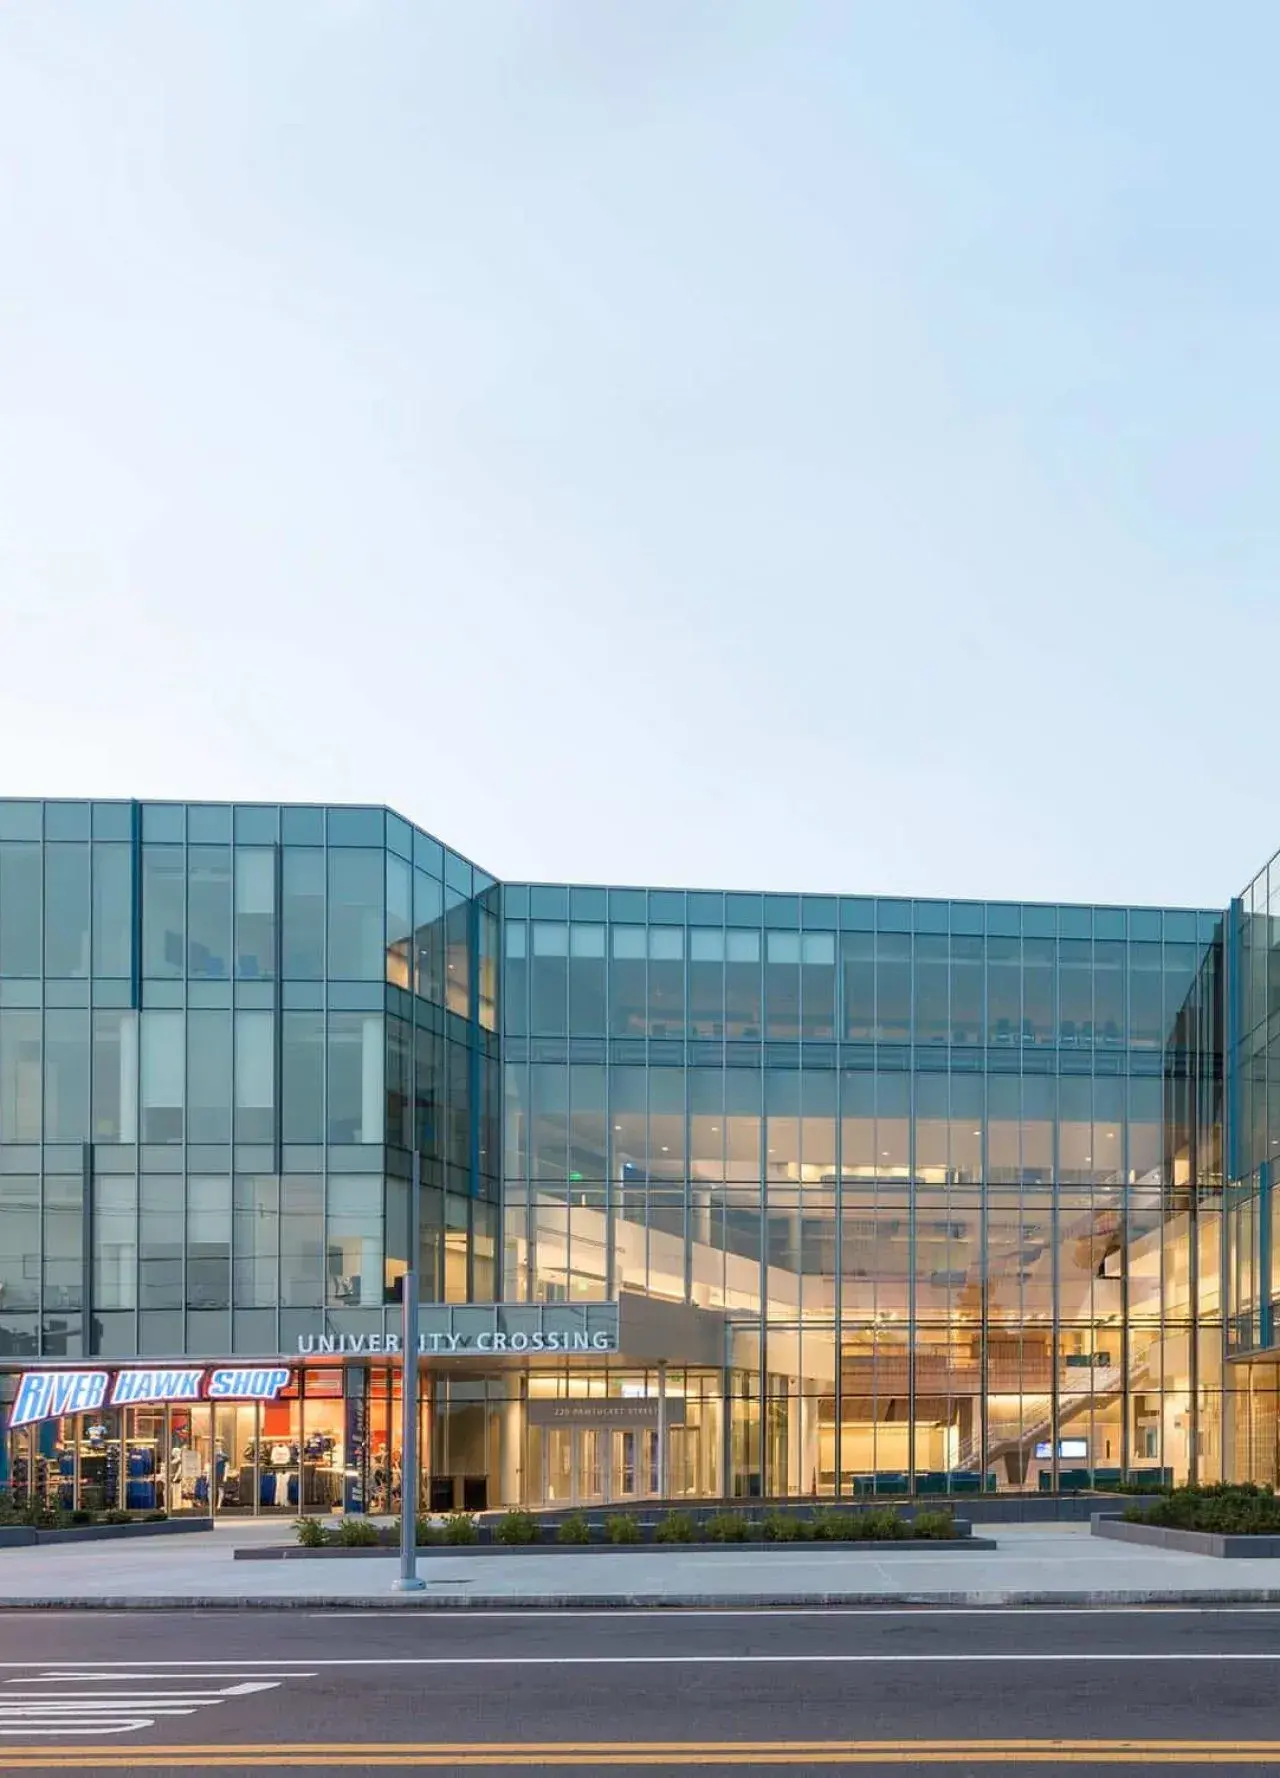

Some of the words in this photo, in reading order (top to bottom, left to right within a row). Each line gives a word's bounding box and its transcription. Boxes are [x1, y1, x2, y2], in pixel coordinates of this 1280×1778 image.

[297, 1333, 461, 1353] UNIVERITY
[476, 1330, 609, 1351] CROSSING
[11, 1371, 107, 1425] RIVER
[112, 1370, 204, 1403] HAWK
[208, 1369, 288, 1398] SHOP
